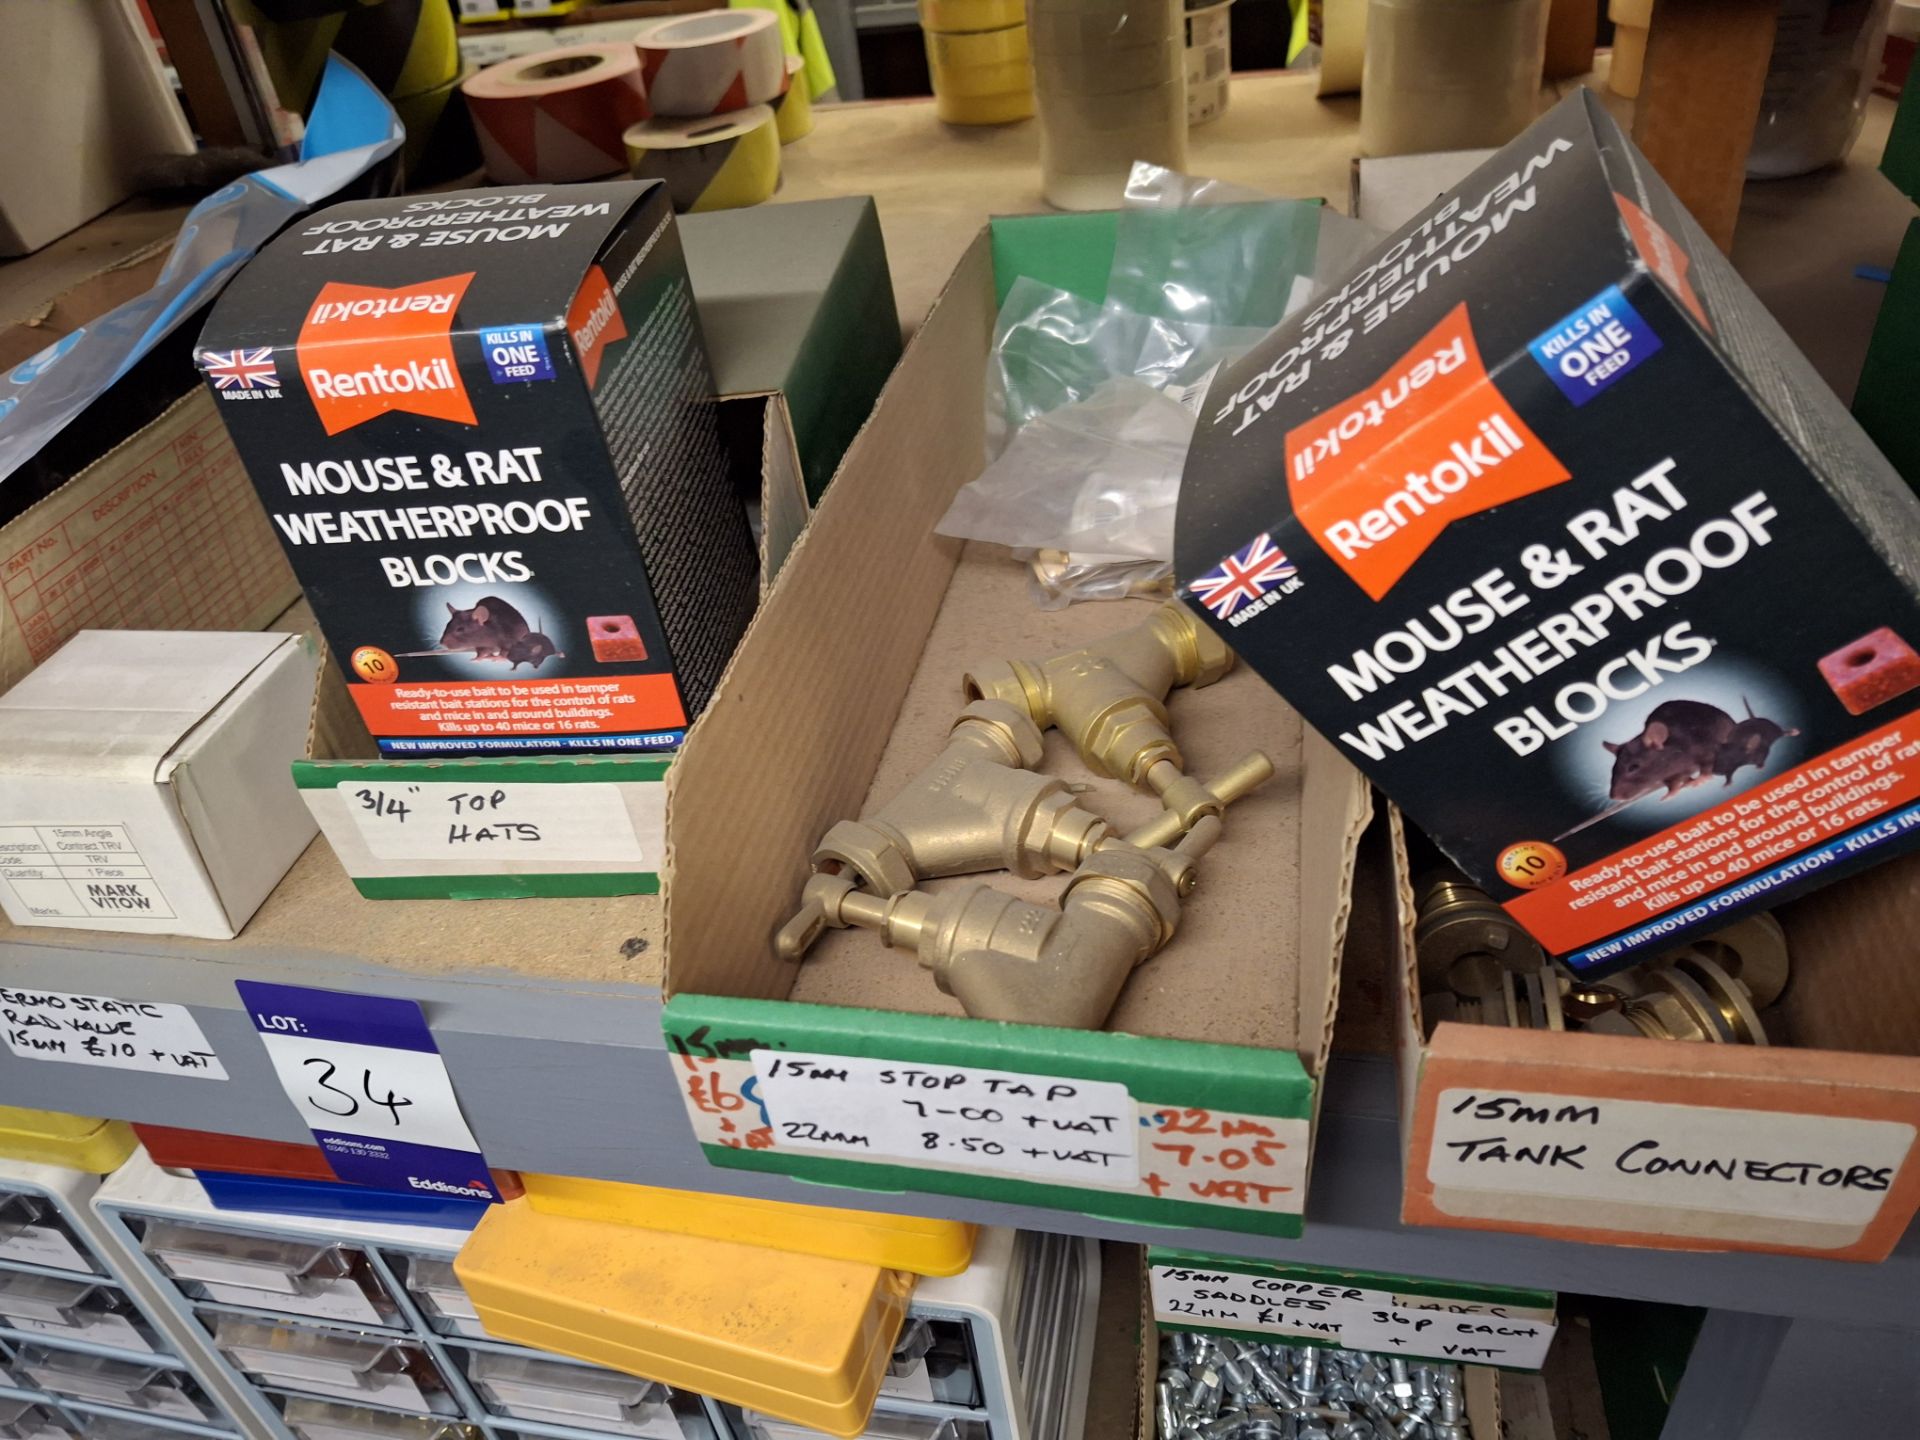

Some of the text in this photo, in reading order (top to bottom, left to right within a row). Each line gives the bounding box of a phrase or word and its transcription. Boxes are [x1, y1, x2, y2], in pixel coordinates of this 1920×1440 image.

[403, 193, 547, 213] BLOCKS
[303, 202, 610, 236] WEATHERPROOF
[303, 222, 571, 256] MOUSE & RAT
[1303, 197, 1460, 331] BLOCKS
[1213, 137, 1574, 425] WEATHERPROOF
[311, 293, 457, 324] Rentokil
[1232, 185, 1538, 437] MOUSE & RAT
[574, 288, 617, 356] Rentokil
[1541, 304, 1612, 359] KILLS IN
[486, 330, 533, 345] KILLS IN
[1560, 320, 1632, 378] ONE
[493, 345, 540, 365] ONE
[308, 358, 455, 399] Rentokil
[504, 364, 536, 377] FEED
[1584, 349, 1630, 386] FEED
[222, 389, 283, 400] MADE IN UK
[1293, 336, 1467, 481] Rentokil
[279, 456, 428, 496] MOUSE
[430, 453, 469, 488] &
[469, 446, 543, 486] RAT
[91, 469, 158, 523] DESCRIPTION
[1324, 413, 1524, 561] Rentokil
[273, 497, 592, 546] WEATHERPROOF
[8, 550, 36, 574] PART
[379, 551, 531, 588] BLOCKS
[1326, 456, 1689, 702] MOUSE & RAT
[1228, 576, 1304, 628] MADE IN UK
[1338, 490, 1780, 762] WEATHERPROOF
[363, 659, 384, 674] 10
[395, 683, 619, 700] Ready-to-use bait to be used in tamper
[1494, 620, 1710, 758] BLOCKS
[390, 694, 635, 710] resistant bait stations for the control of rats
[419, 708, 614, 721] and mice in and around buildings.
[438, 720, 600, 733] Kills up to 40 mice or 16 rats.
[390, 735, 675, 750] NEW IMPROVED FORMULATION KILLS IN ONE FEED
[448, 792, 506, 815] TOP
[1569, 838, 1678, 892] Ready-to-use
[1676, 820, 1715, 843] bait
[1712, 812, 1735, 825] to
[1733, 799, 1762, 816] be
[1762, 774, 1808, 803] used
[1808, 767, 1831, 781] in
[1830, 732, 1902, 770] tamper
[52, 829, 113, 839] 15mm Angle
[449, 823, 541, 844] HATS
[1568, 752, 1893, 910] resistant bait stations for the control of
[1613, 771, 1905, 908] and mice in and around buildings.
[56, 841, 122, 851] Contract TRV
[1643, 798, 1888, 911] Kills up to 40 mice or 16 rats.
[85, 855, 108, 863] TRV
[1516, 856, 1545, 876] 10
[3, 868, 124, 879] Quantity Piece
[86, 884, 143, 897] MARK
[1585, 942, 1622, 962] NEW
[1622, 906, 1708, 947] IMPROVED
[1709, 850, 1834, 911] FORMULATION
[1844, 822, 1898, 852] KILLS
[90, 897, 151, 909] VITOW
[3, 1009, 61, 1030] RAD
[257, 1014, 308, 1033] LOT:
[81, 1036, 135, 1057] £10
[304, 1058, 413, 1126] 34
[879, 1069, 966, 1091] STOP
[984, 1078, 1078, 1101] TAP
[323, 1137, 386, 1152] eddisons.com
[921, 1131, 1005, 1156] 8.50
[1447, 1137, 1894, 1191] TANK CONNECTORS
[407, 1176, 493, 1200] Eddisons
[1194, 1289, 1332, 1312] SADDLES
[1252, 1278, 1364, 1302] COPPER
[1457, 1323, 1539, 1338] EACH
[1443, 1344, 1506, 1358] VAT
